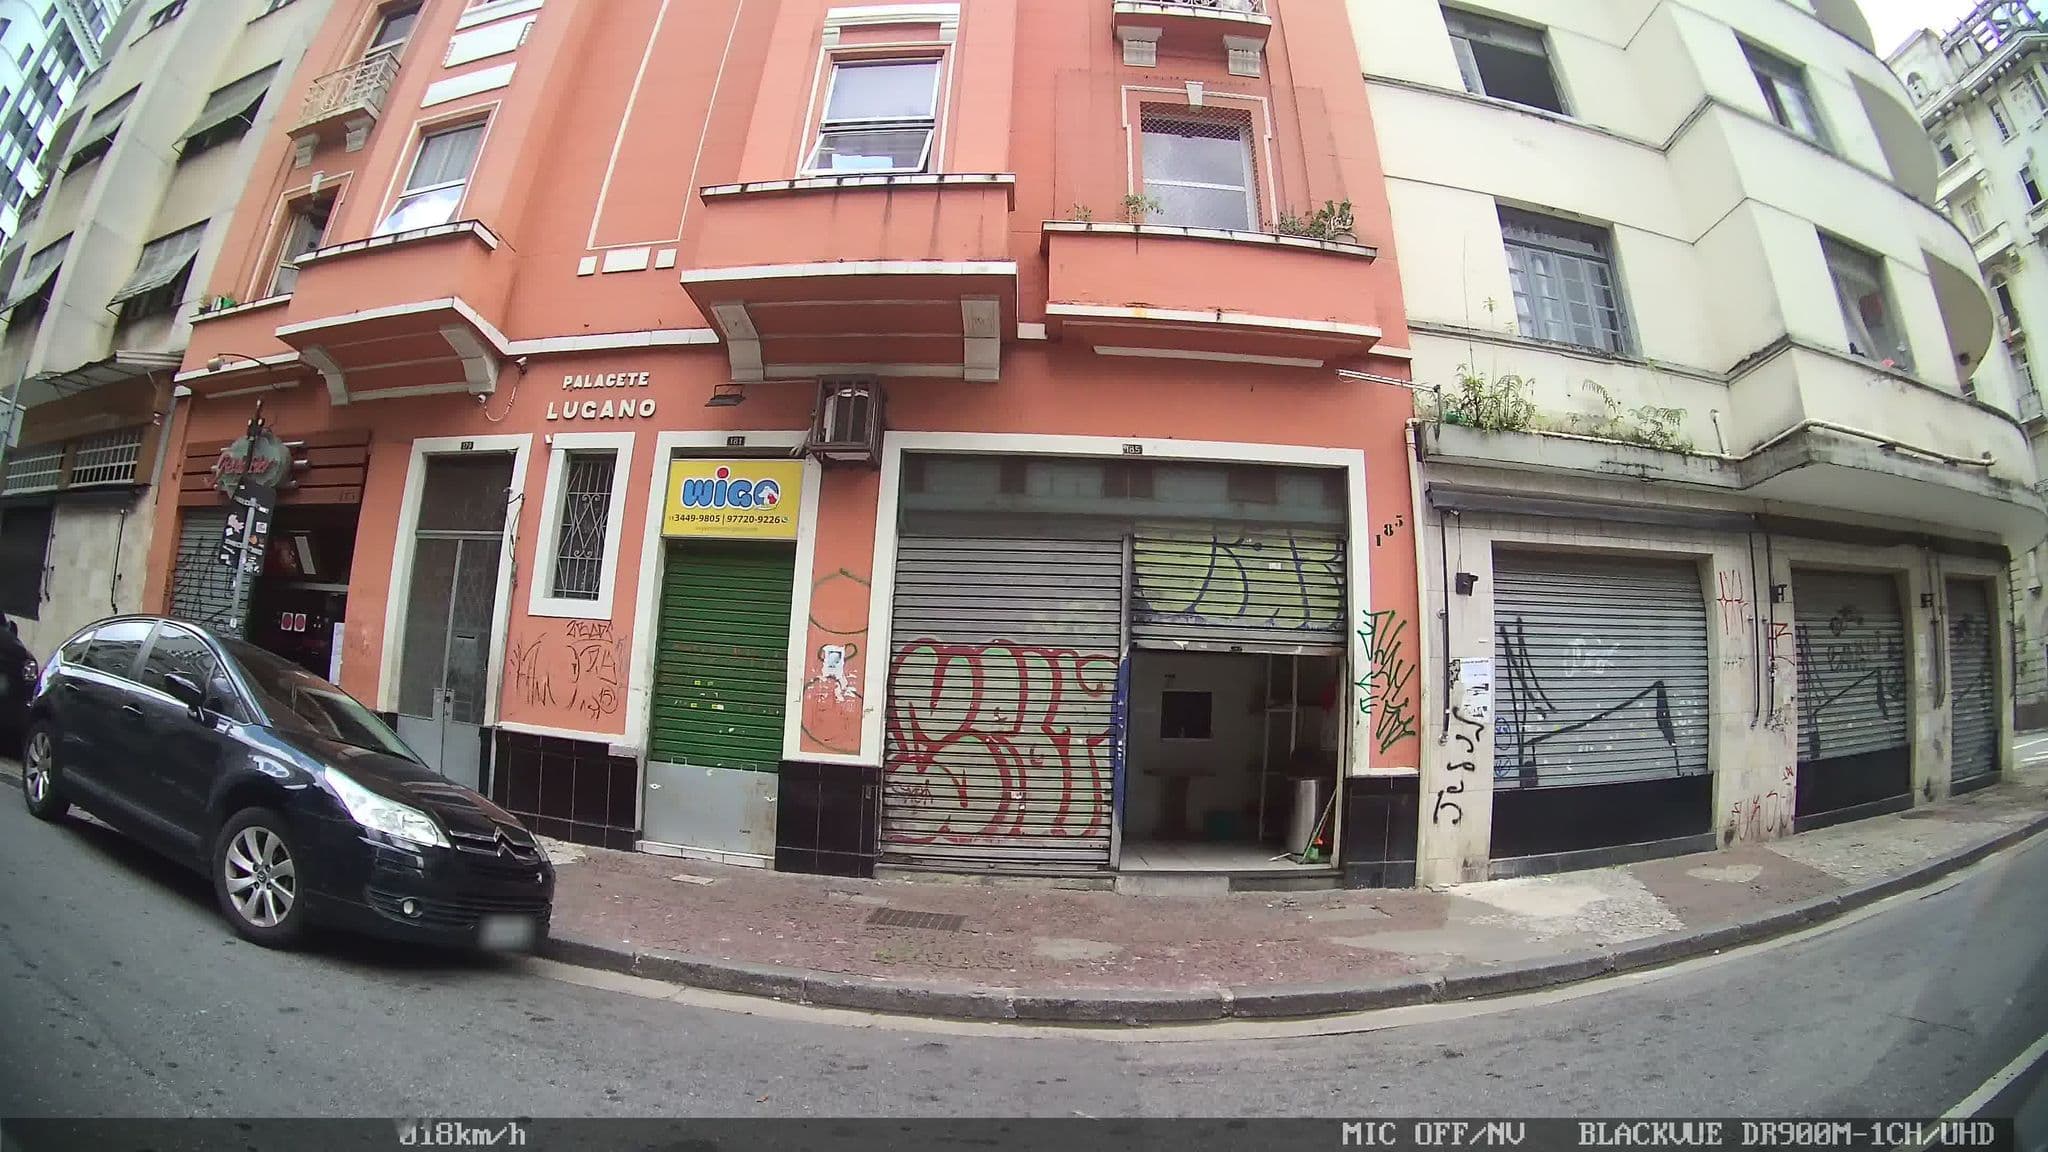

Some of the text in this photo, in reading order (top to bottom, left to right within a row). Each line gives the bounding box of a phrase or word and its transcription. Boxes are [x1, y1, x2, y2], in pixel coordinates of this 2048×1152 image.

[562, 371, 650, 390] PALACETE
[546, 398, 656, 420] LUGANO
[674, 513, 720, 523] 3449-9805
[726, 515, 781, 524] 97720-9226
